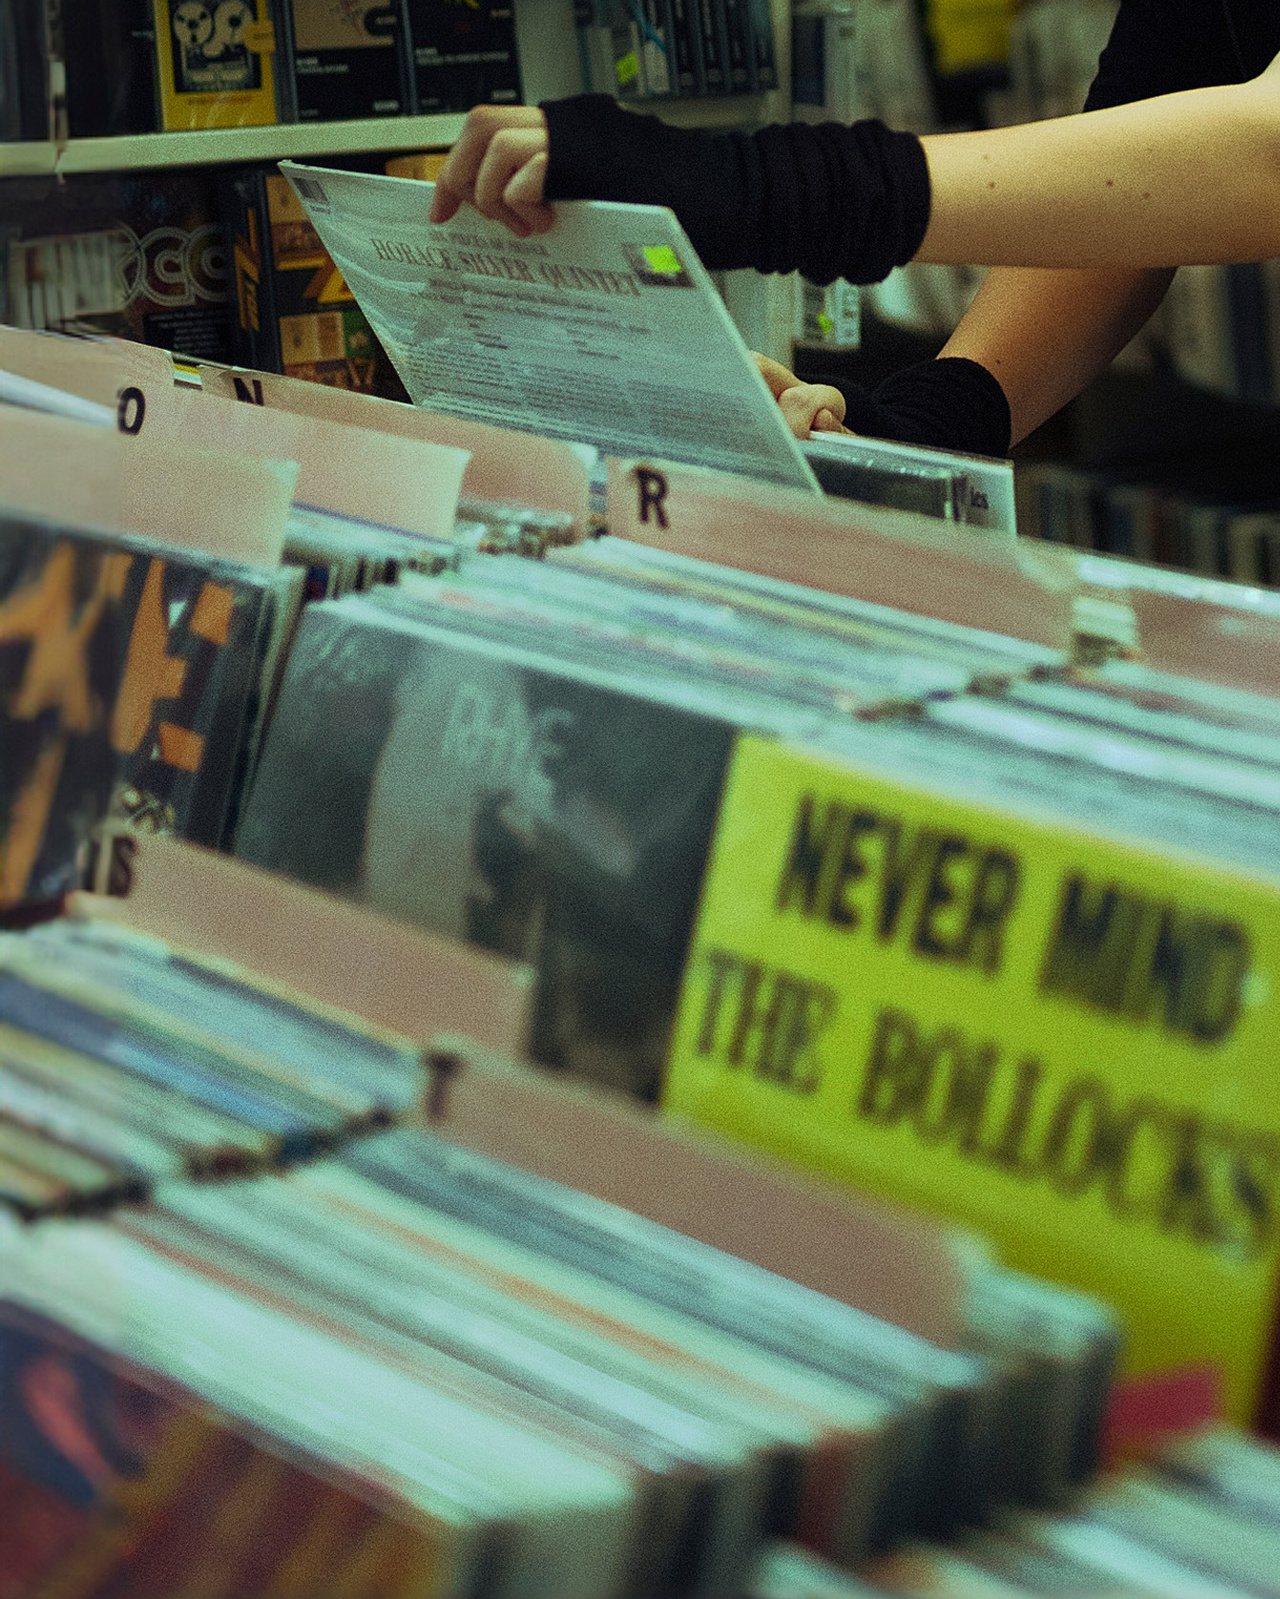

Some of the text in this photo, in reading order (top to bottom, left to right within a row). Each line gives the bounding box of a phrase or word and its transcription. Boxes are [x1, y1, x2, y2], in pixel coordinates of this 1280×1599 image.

[633, 464, 672, 529] R
[773, 788, 1254, 1050] NEVER MIND
[693, 945, 840, 1100] THE
